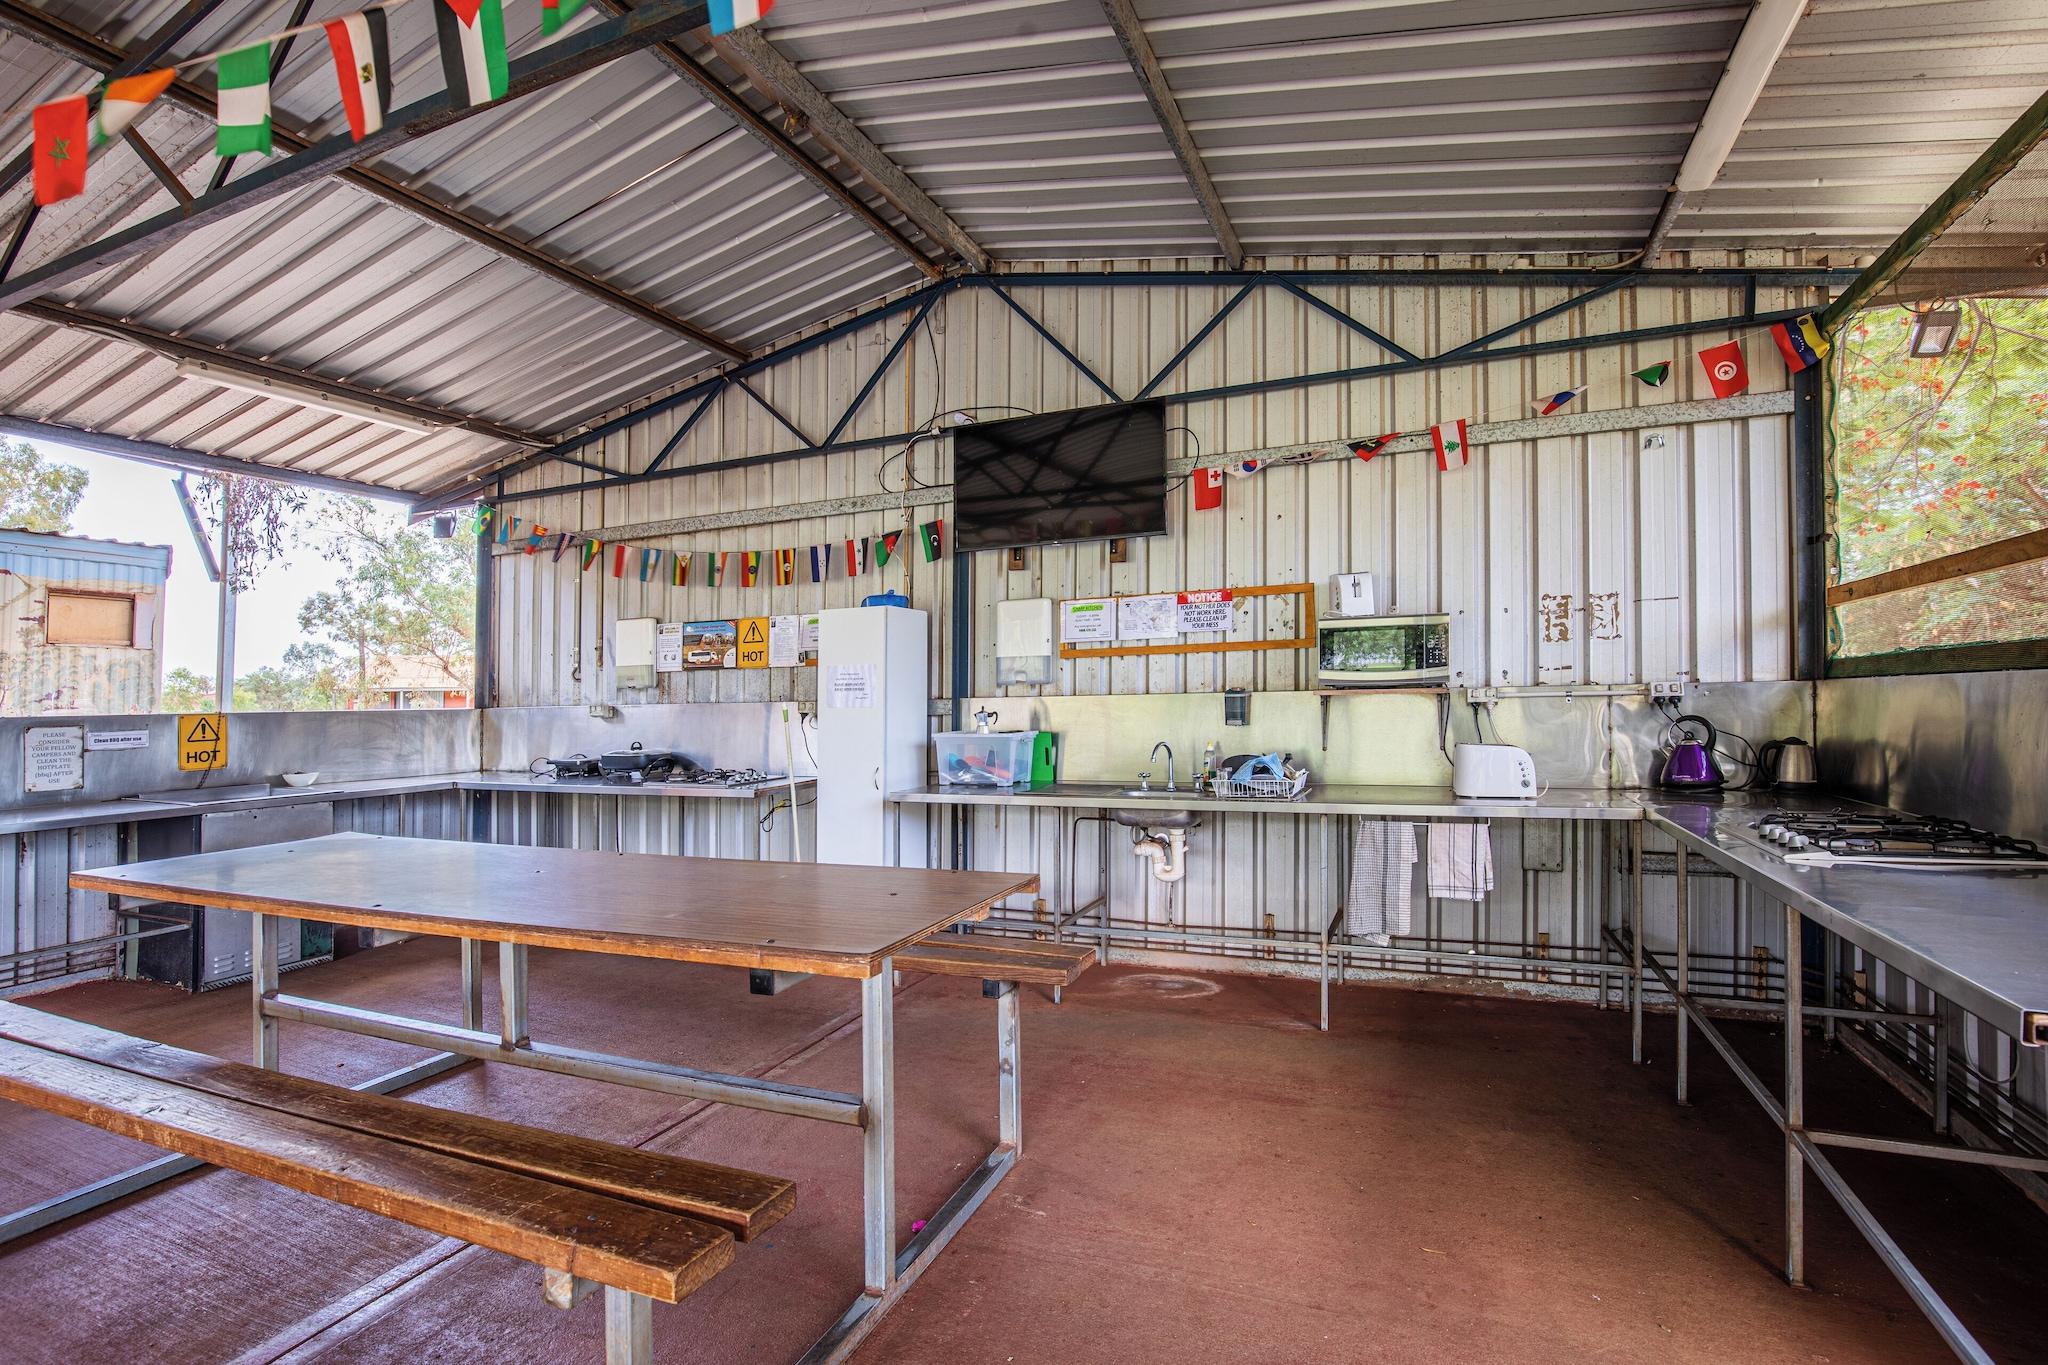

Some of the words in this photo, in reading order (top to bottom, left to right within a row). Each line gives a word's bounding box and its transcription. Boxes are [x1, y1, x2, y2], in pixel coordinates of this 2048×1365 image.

[1187, 592, 1222, 603] NOTICE
[743, 651, 764, 662] HOT
[186, 750, 220, 764] HOT
